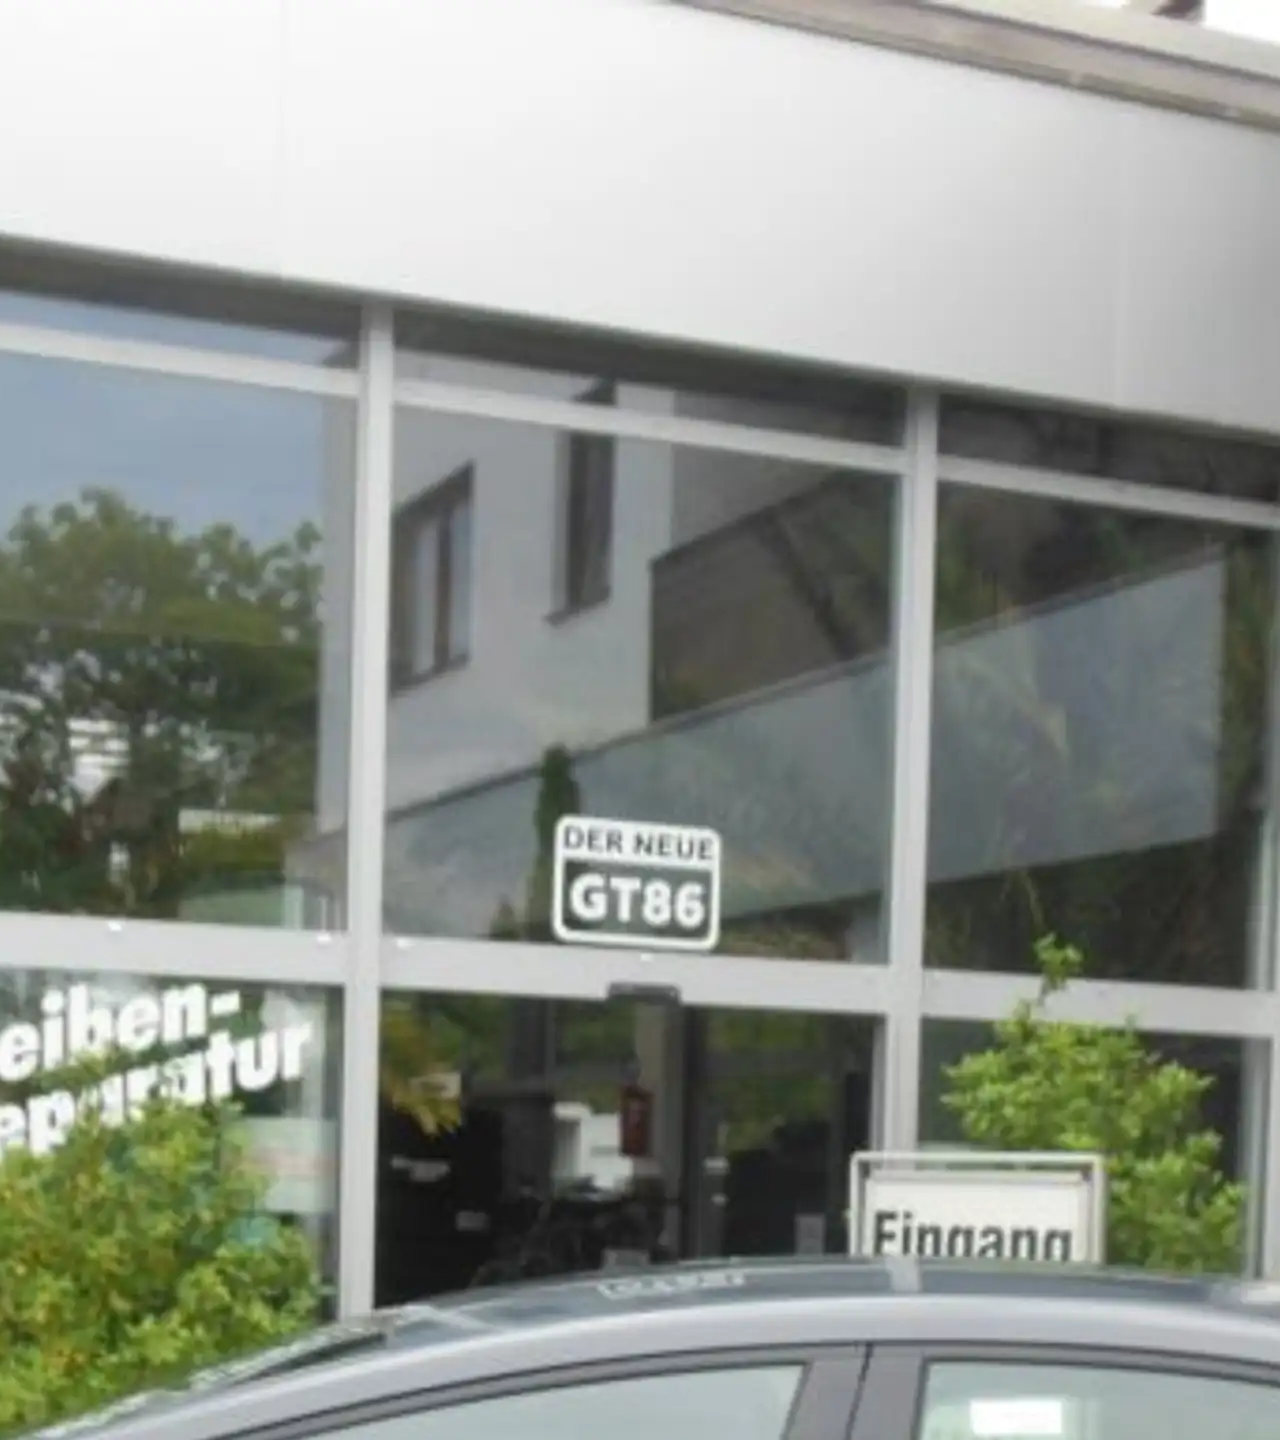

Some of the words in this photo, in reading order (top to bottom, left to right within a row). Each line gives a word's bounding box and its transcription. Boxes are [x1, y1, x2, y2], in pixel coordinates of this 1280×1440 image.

[564, 825, 623, 853] DER
[634, 832, 715, 860] NEUE
[570, 872, 705, 929] GT86
